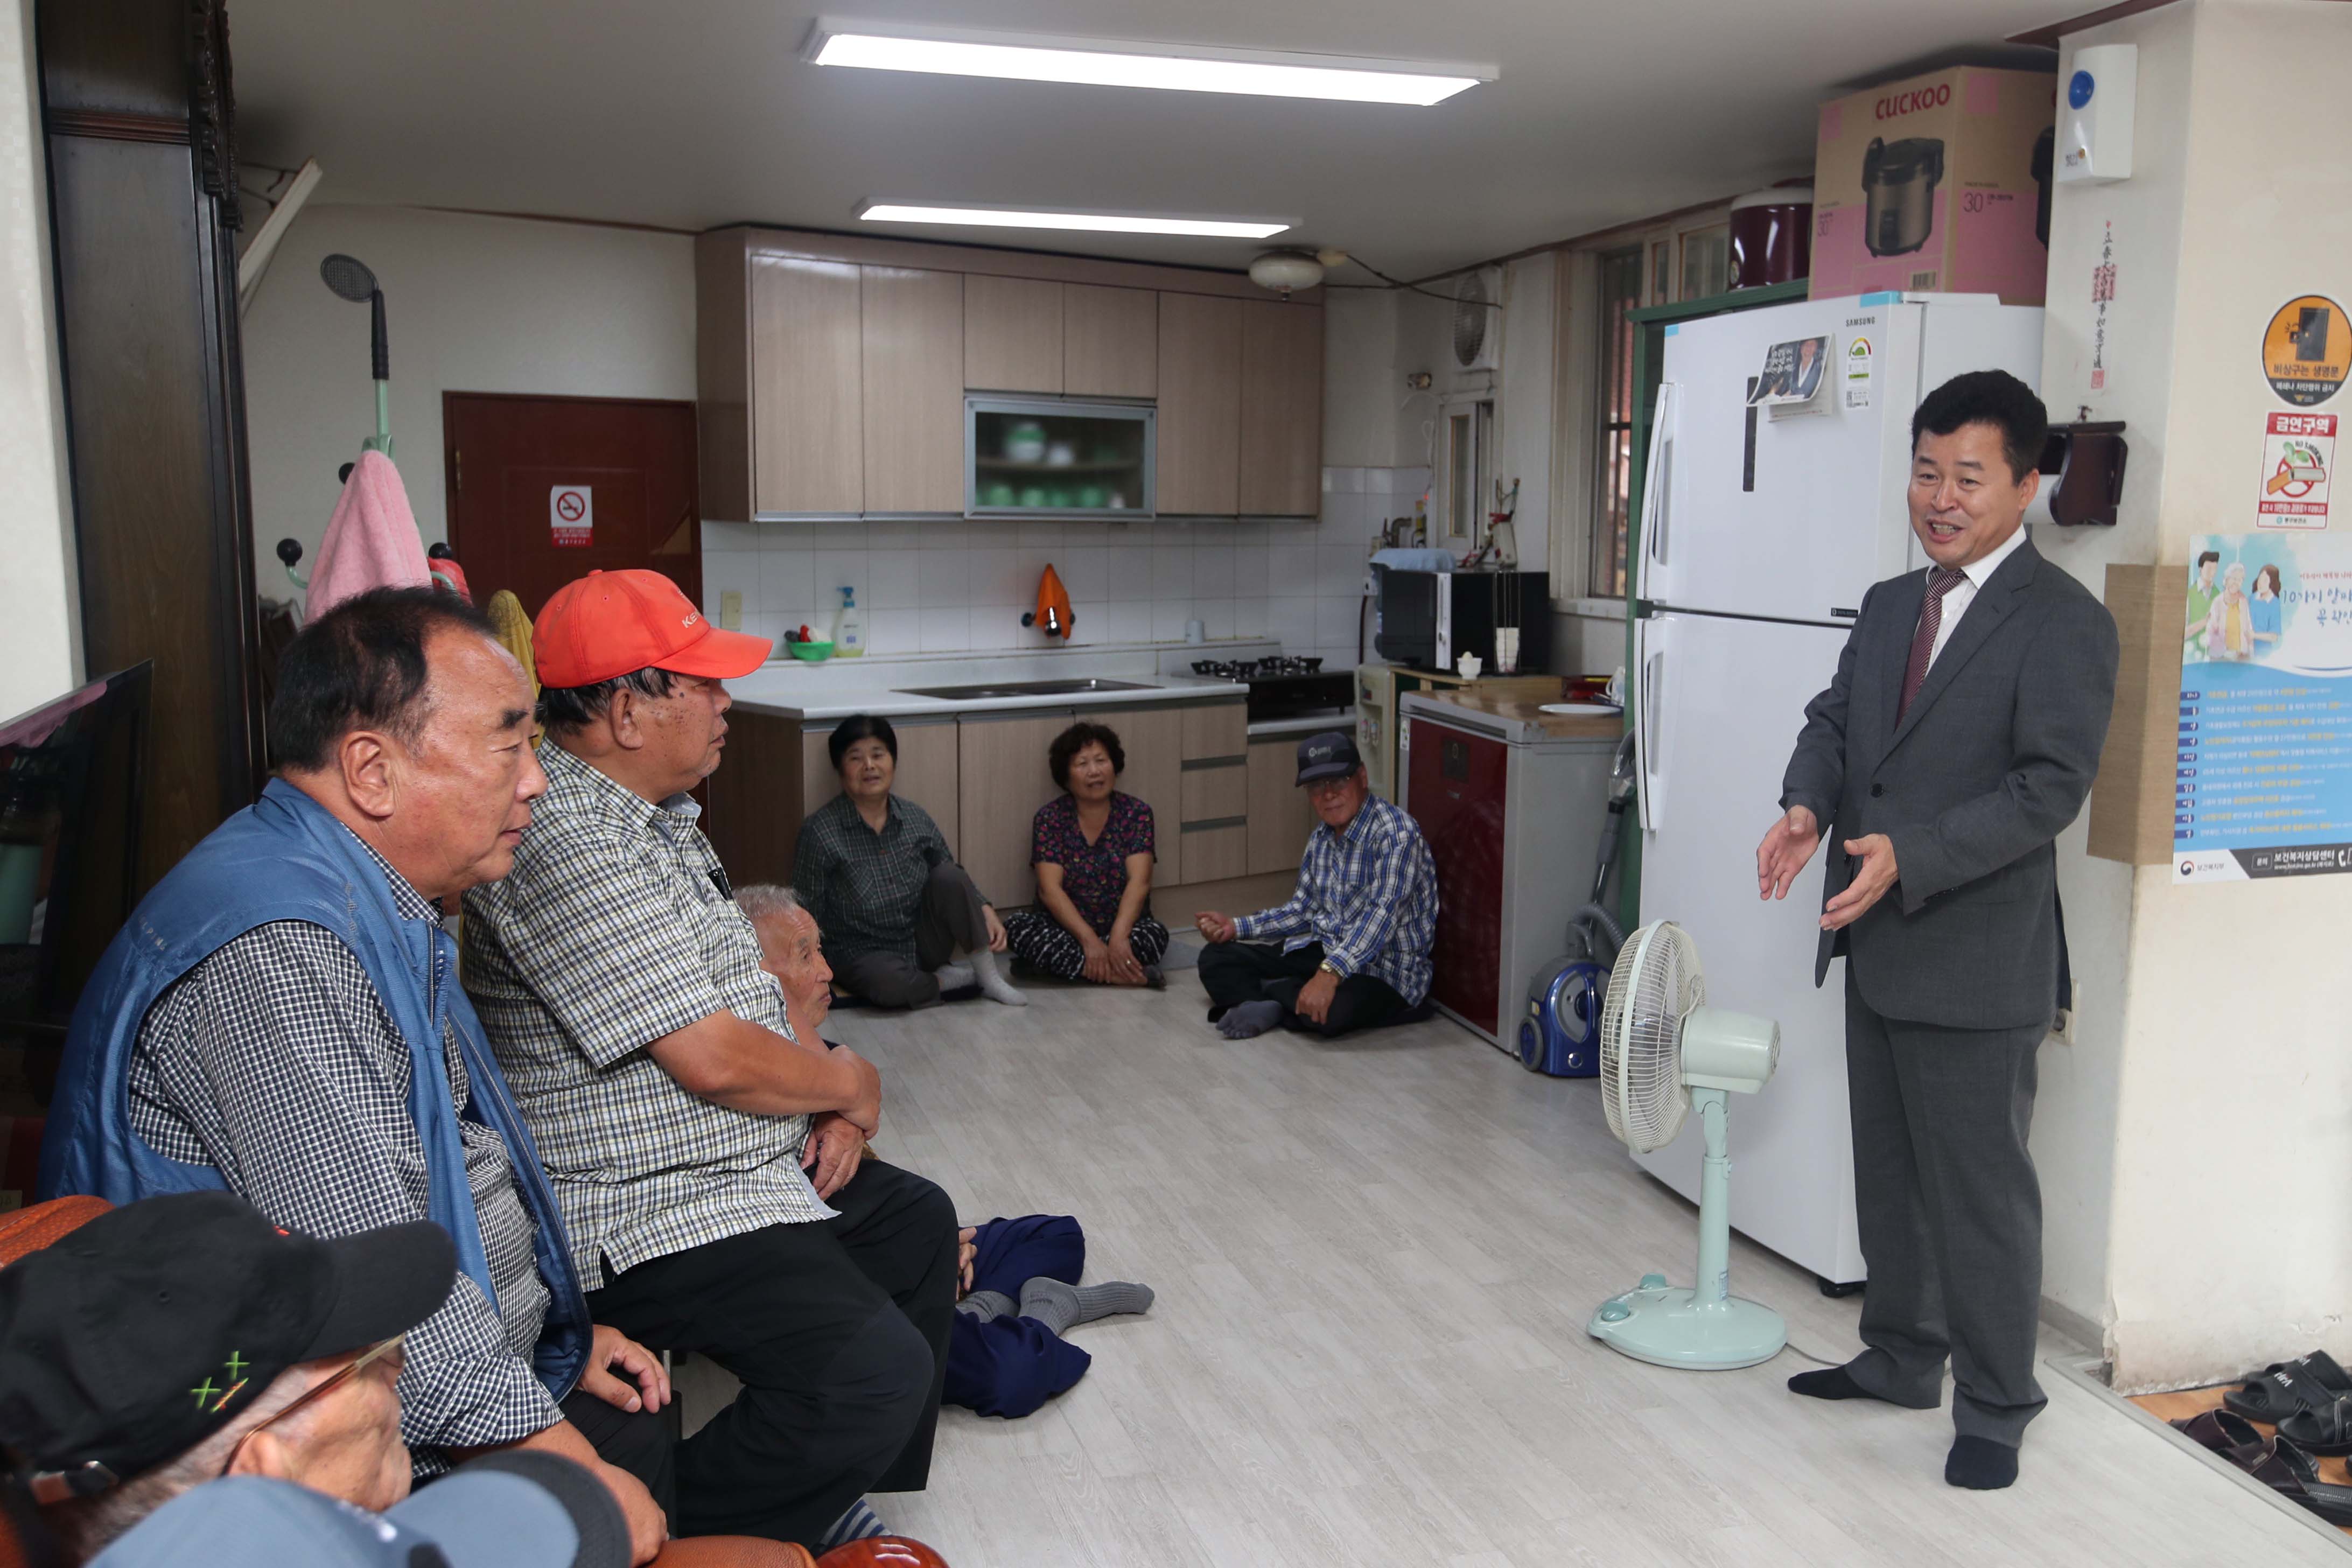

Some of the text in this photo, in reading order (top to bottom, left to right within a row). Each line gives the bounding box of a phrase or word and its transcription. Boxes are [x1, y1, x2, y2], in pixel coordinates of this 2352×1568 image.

[1875, 83, 1951, 120] CUCKOO
[1963, 192, 1983, 213] 30
[1846, 316, 1875, 327] SAMSUNG
[2273, 363, 2309, 376] 비상구는
[2276, 416, 2329, 434] 금연구역
[2274, 850, 2335, 862] 보건복지상담센터
